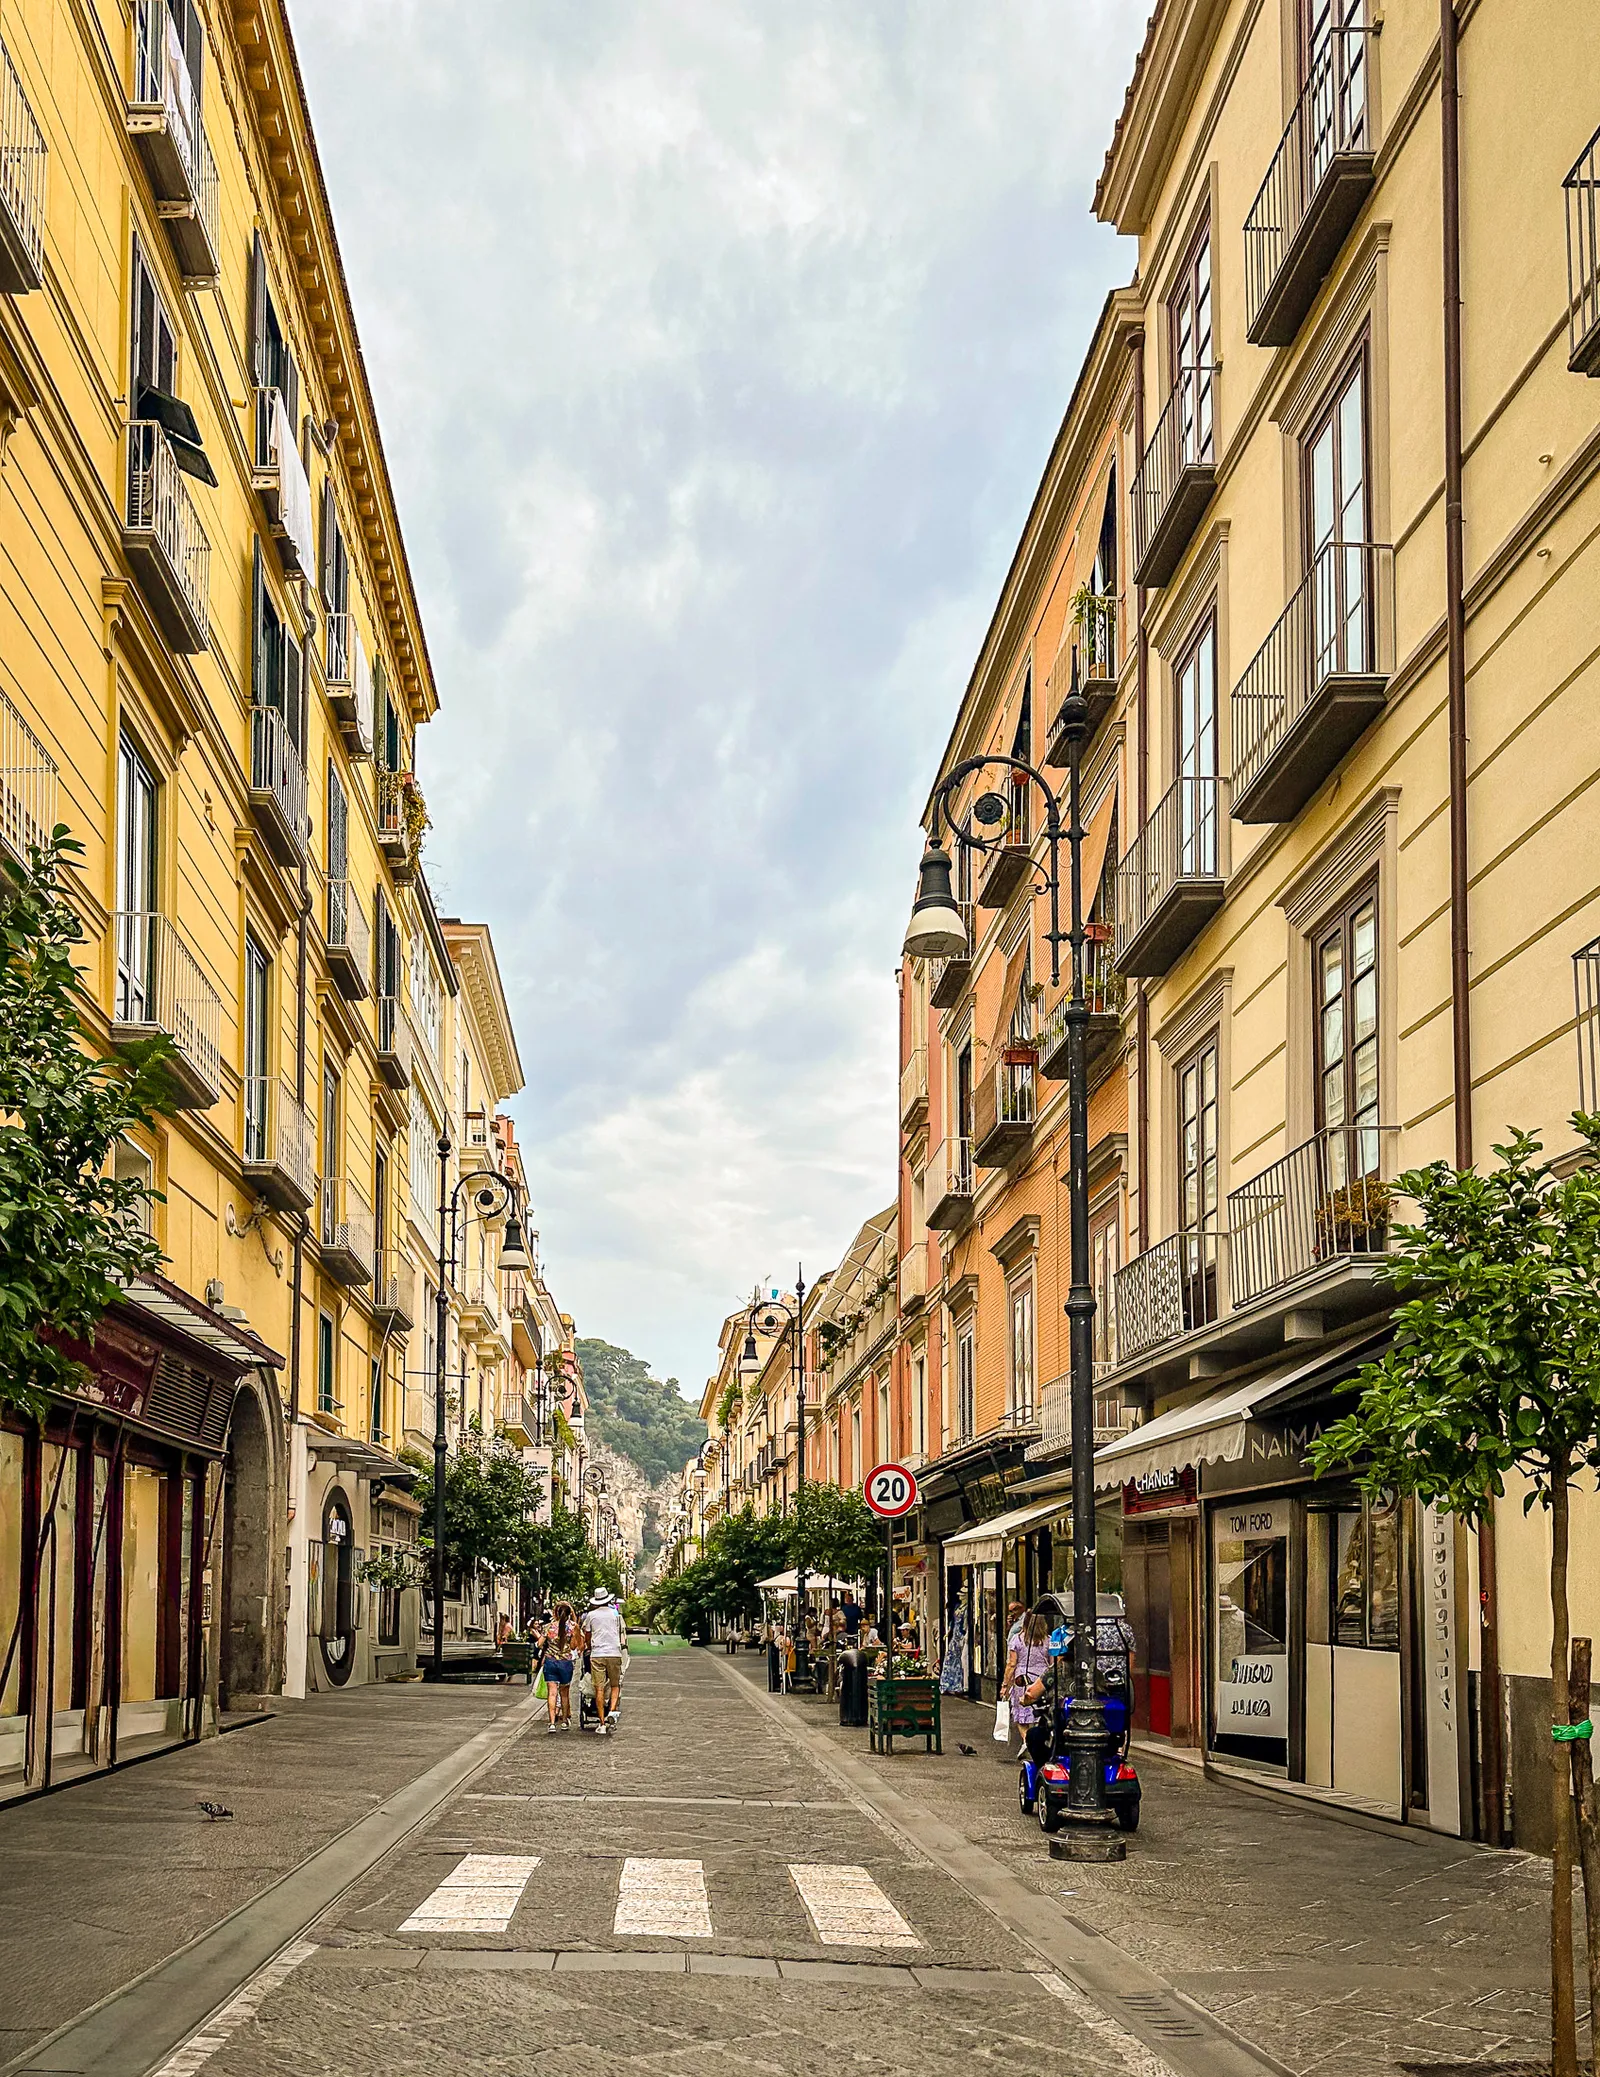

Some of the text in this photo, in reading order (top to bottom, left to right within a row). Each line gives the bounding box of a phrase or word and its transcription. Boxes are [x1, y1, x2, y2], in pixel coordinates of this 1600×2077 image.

[876, 1477, 905, 1502] 20
[1230, 1513, 1272, 1533] TOM FORD
